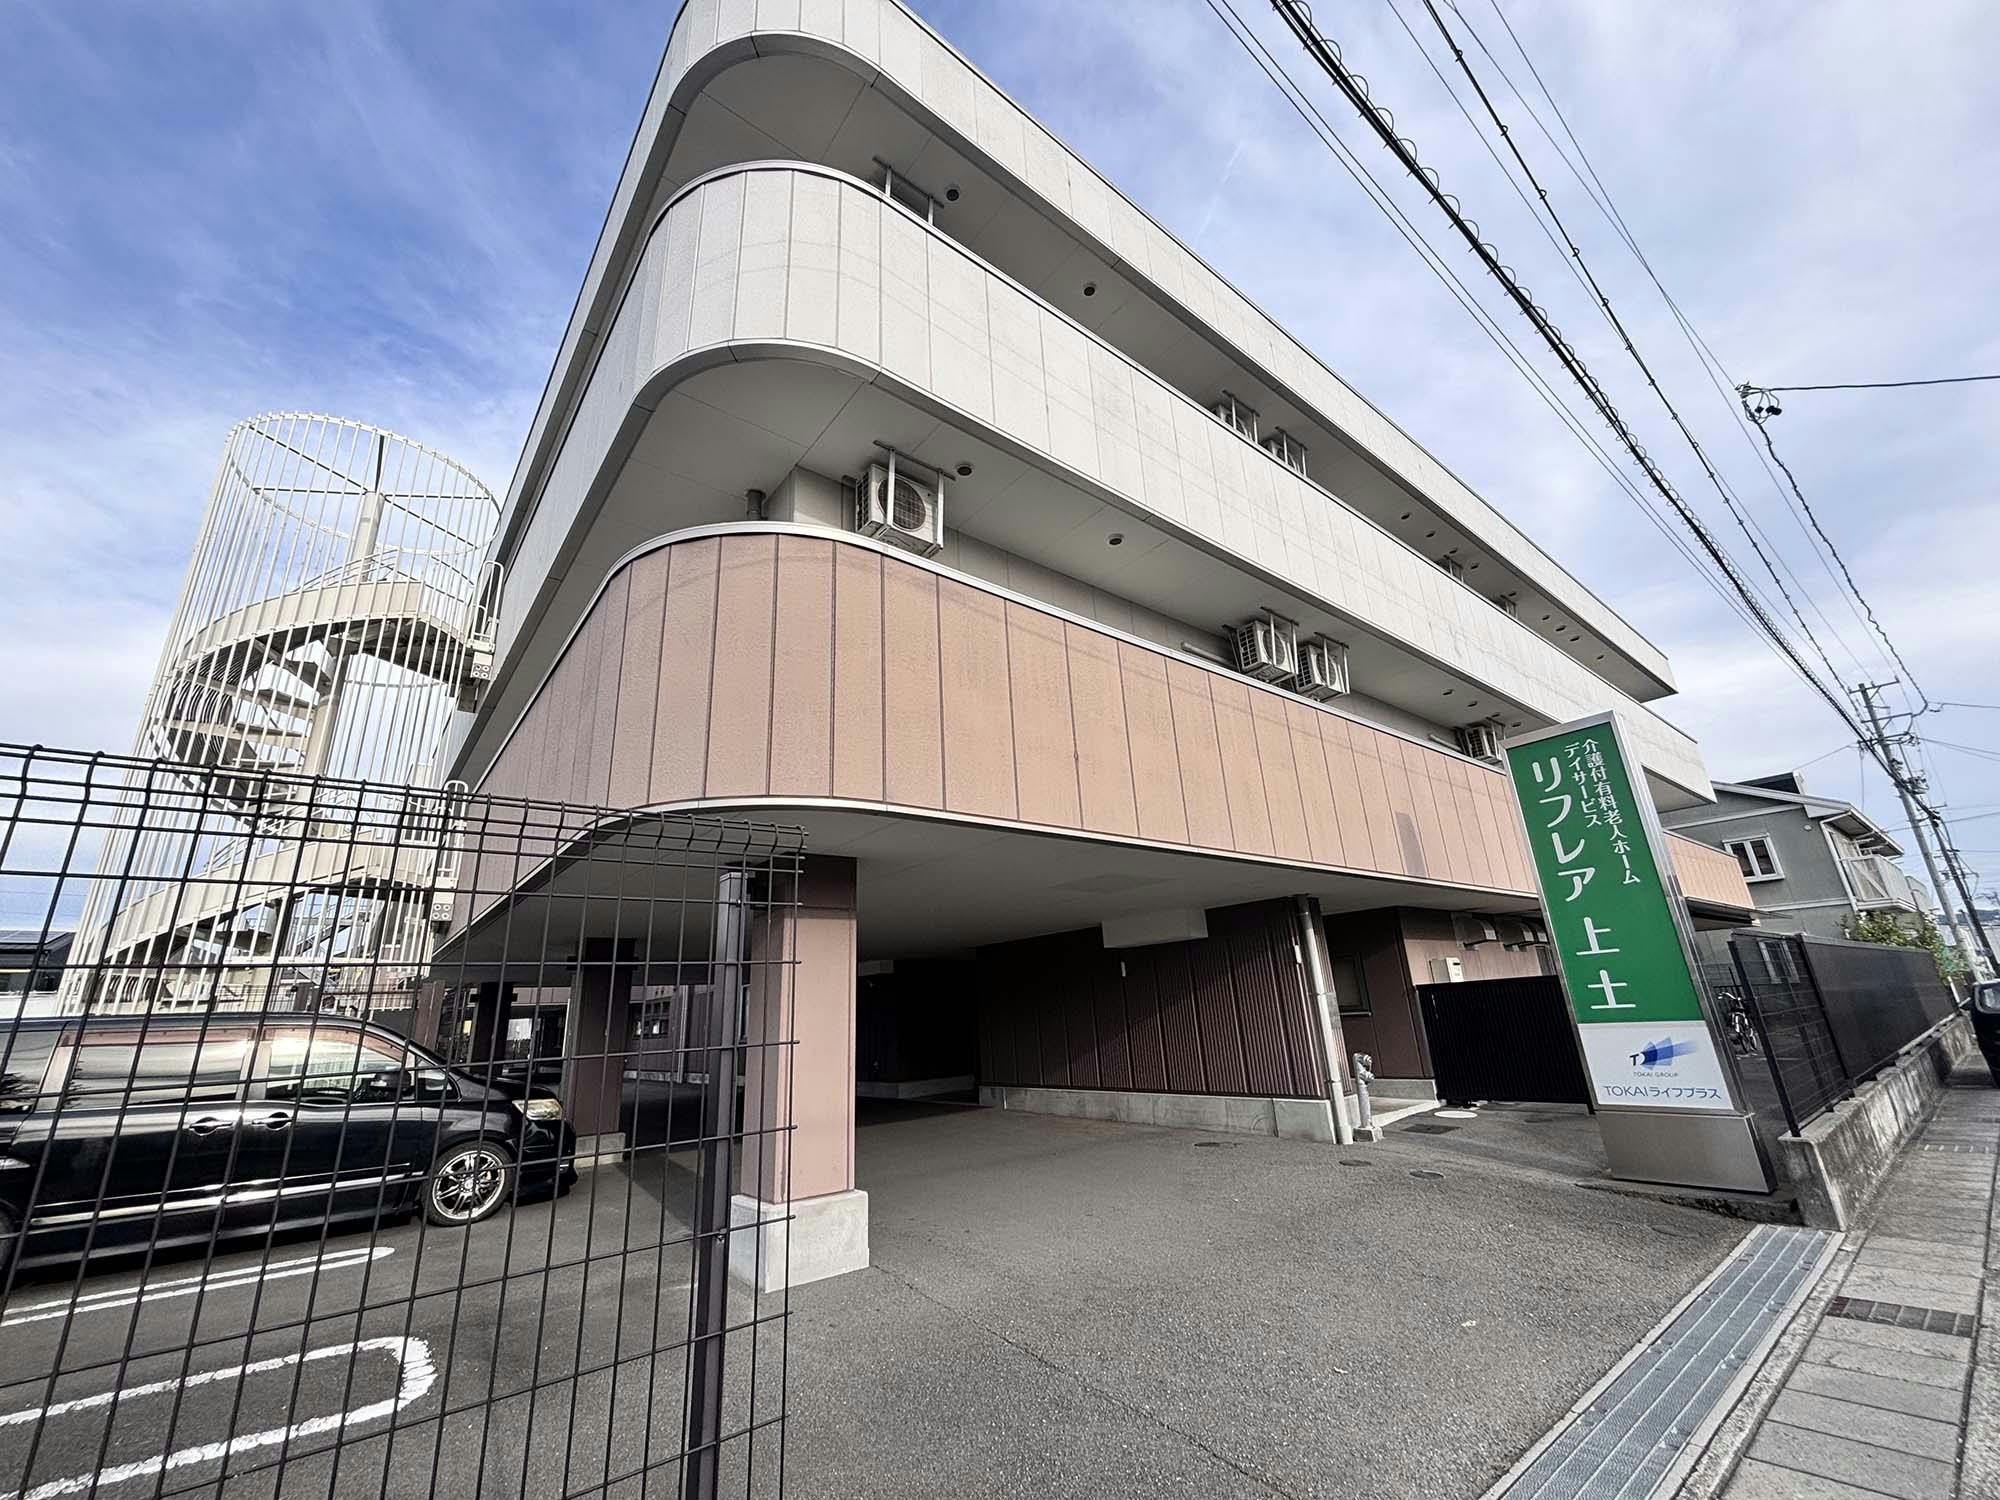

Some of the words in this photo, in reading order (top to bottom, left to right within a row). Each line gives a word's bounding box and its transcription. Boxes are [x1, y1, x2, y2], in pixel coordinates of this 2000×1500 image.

[1564, 742, 1602, 828] デイサービス
[1581, 738, 1641, 885] 介護付有料老人ホーム
